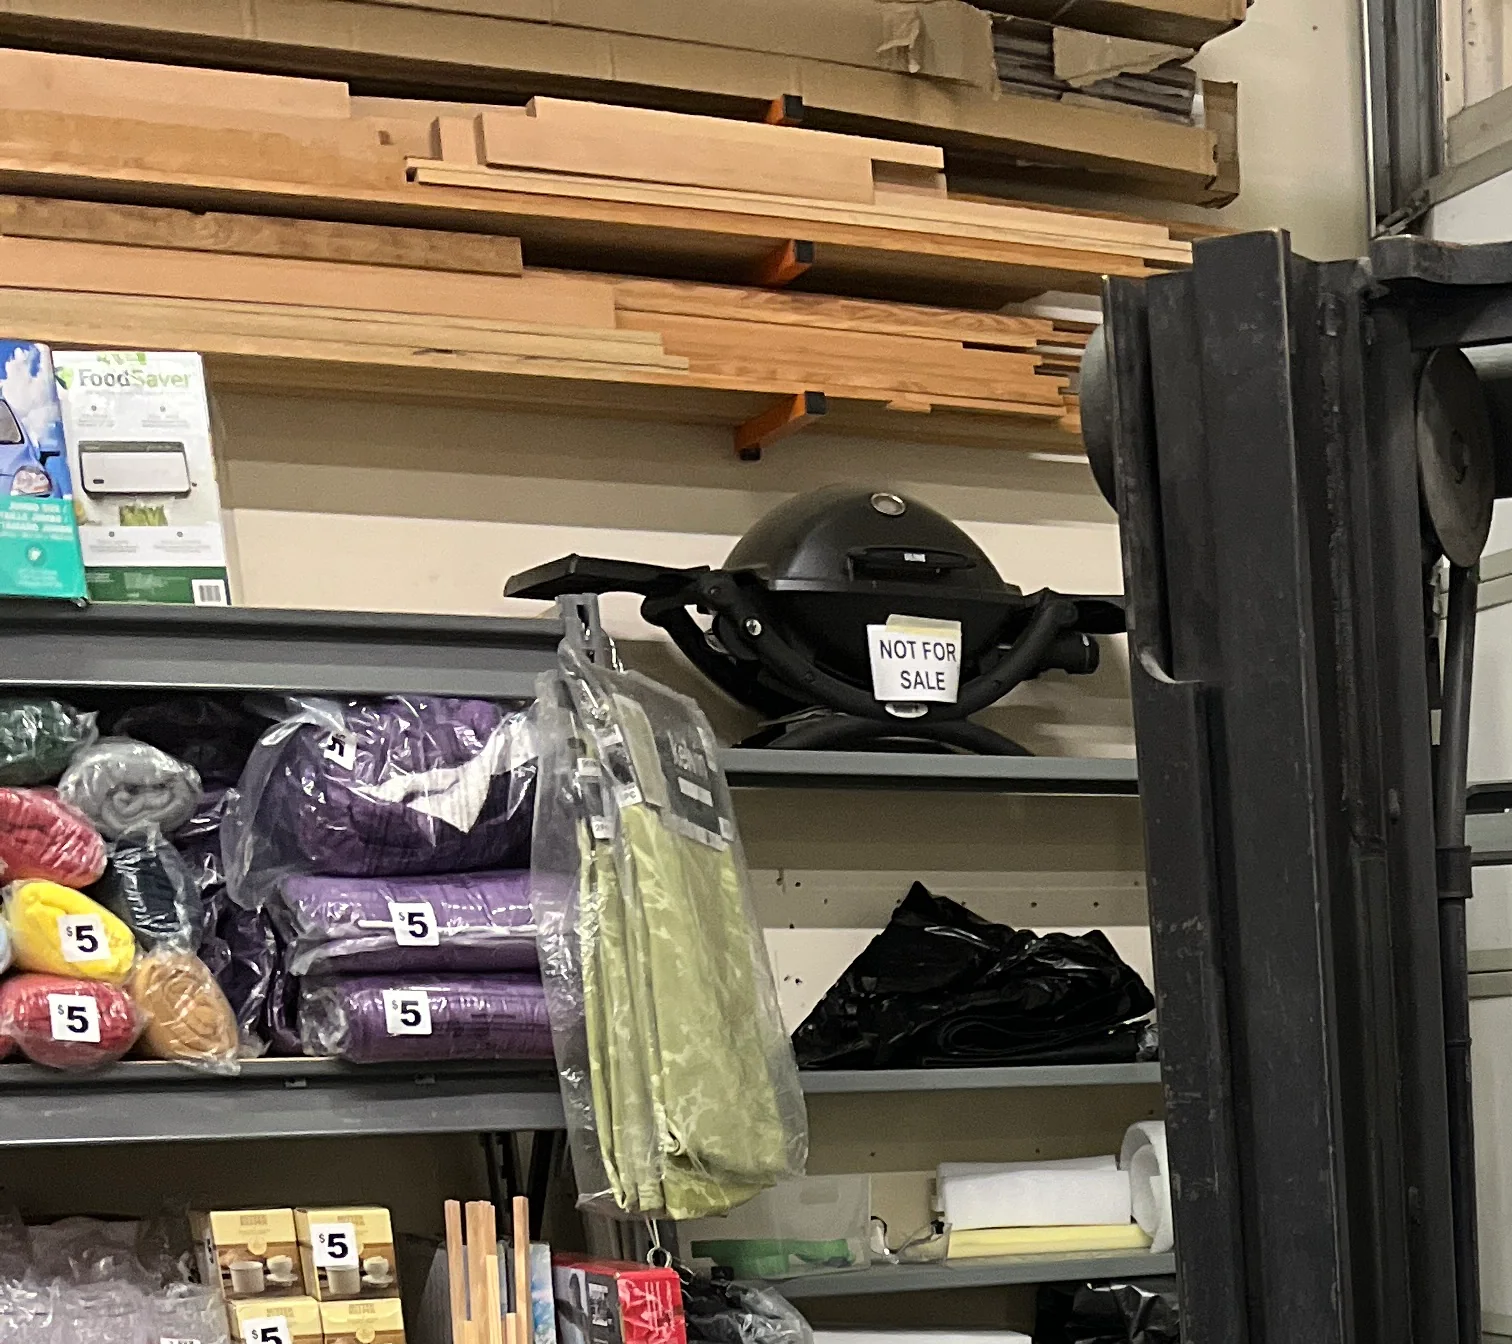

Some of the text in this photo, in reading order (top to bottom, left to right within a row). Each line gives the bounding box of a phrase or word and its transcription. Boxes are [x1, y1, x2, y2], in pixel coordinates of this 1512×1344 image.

[78, 368, 193, 388] FoodSaver
[879, 639, 957, 662] NOT FOR
[900, 670, 946, 691] SALE
[397, 907, 429, 939] $5
[65, 924, 99, 953] $5
[57, 1004, 89, 1034] $5
[391, 999, 422, 1027] $5
[318, 1232, 349, 1259] $5
